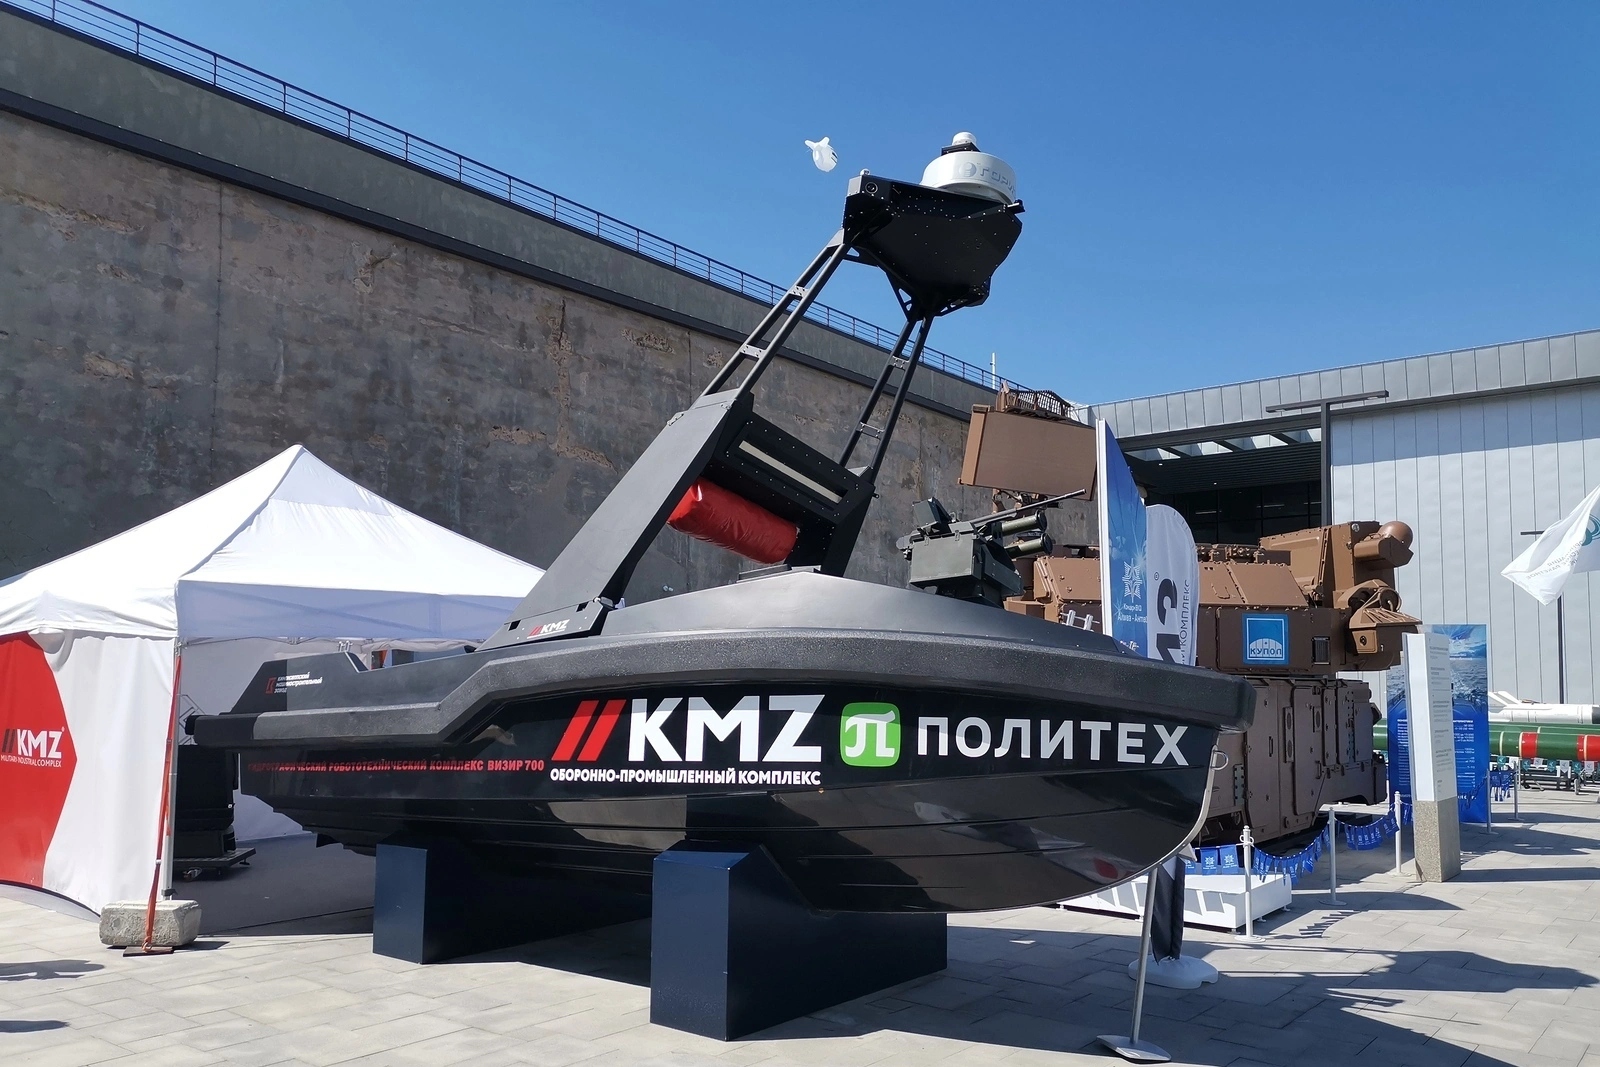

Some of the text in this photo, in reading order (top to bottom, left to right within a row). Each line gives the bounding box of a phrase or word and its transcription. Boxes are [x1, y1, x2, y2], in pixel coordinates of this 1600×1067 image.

[1179, 579, 1191, 647] КОМПЛЕКС
[540, 619, 570, 634] KMZ
[628, 694, 825, 763] KMZ
[17, 728, 62, 758] KMZ
[917, 716, 1190, 766] ПОЛИТЕХ
[37, 759, 62, 767] COMPLEX
[328, 759, 427, 772] РОБОТОТЕХНИЧЕСКИЙ
[429, 759, 484, 771] КОМПЛЕКС
[487, 760, 523, 771] ВИЗИР
[525, 760, 544, 771] 700
[550, 767, 822, 786] ОБОРОННО-ПРОМЫШЛЕННЫЙ КОМПЛЕКС
